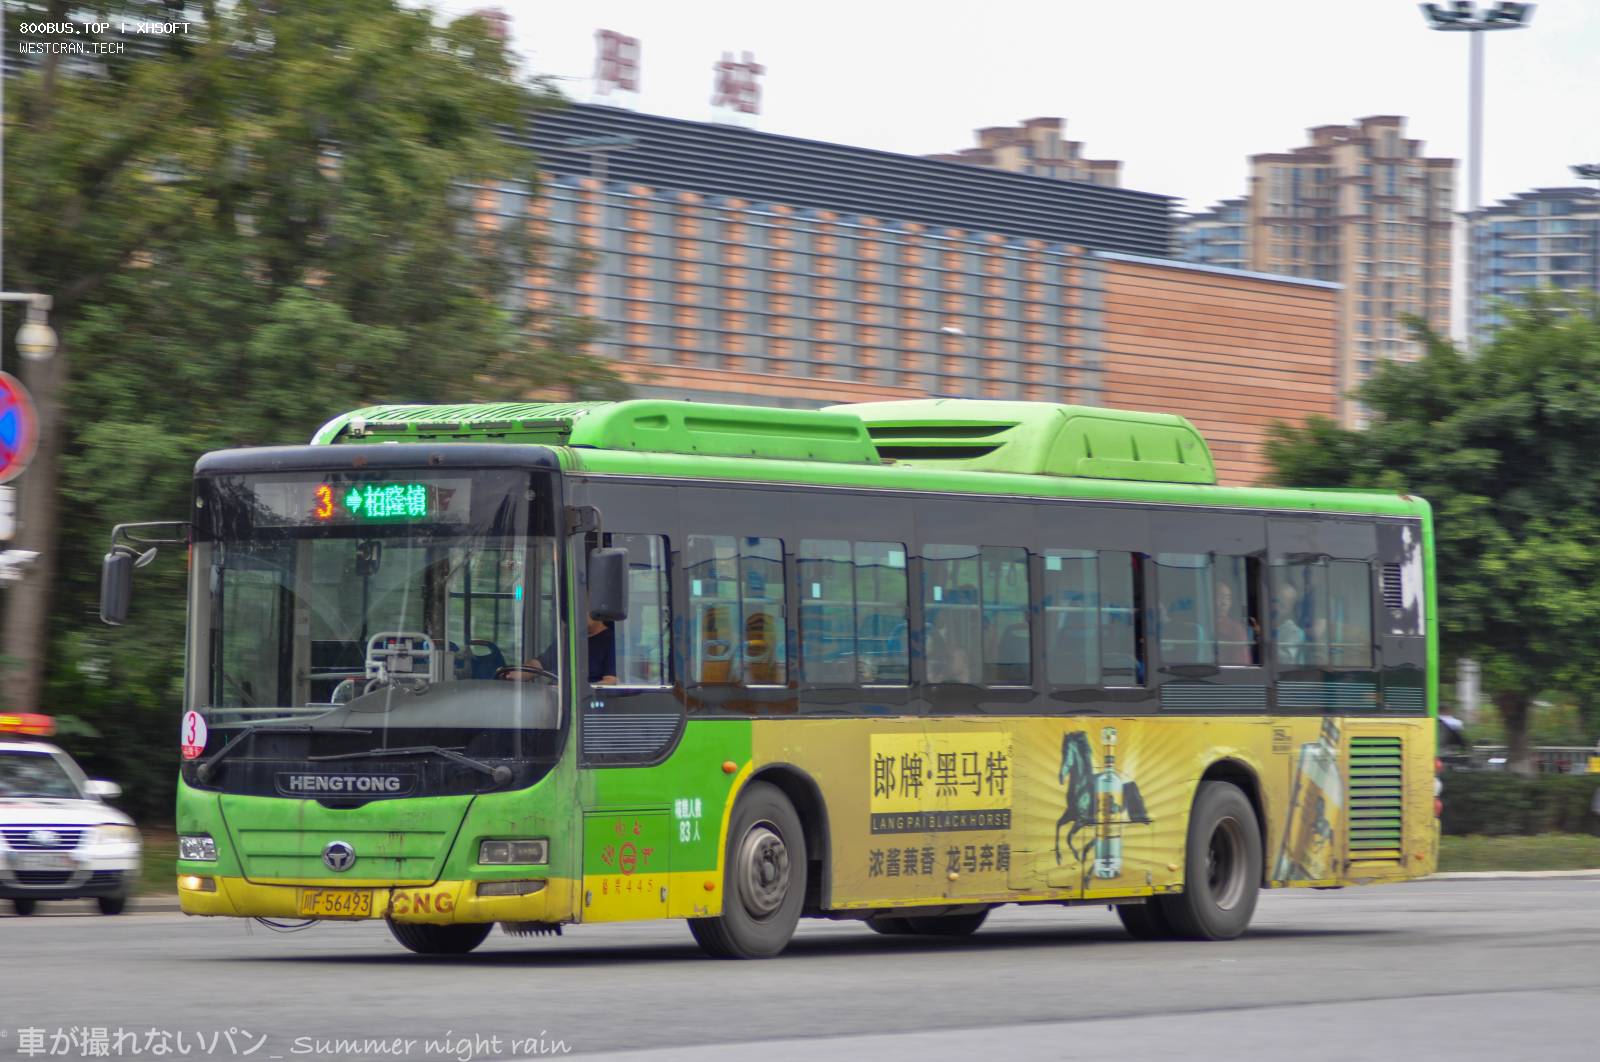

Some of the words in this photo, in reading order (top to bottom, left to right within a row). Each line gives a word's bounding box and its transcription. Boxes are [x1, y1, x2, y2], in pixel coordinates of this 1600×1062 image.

[315, 484, 334, 518] 3
[364, 484, 427, 517] 柏隆镇
[187, 712, 197, 746] 3
[289, 775, 401, 791] HENGTONG
[873, 751, 1009, 799] 郎牌·黑马特
[868, 846, 936, 878] 浓酱兼香
[946, 843, 1011, 873] 龙马奔腾
[391, 892, 455, 915] CNG
